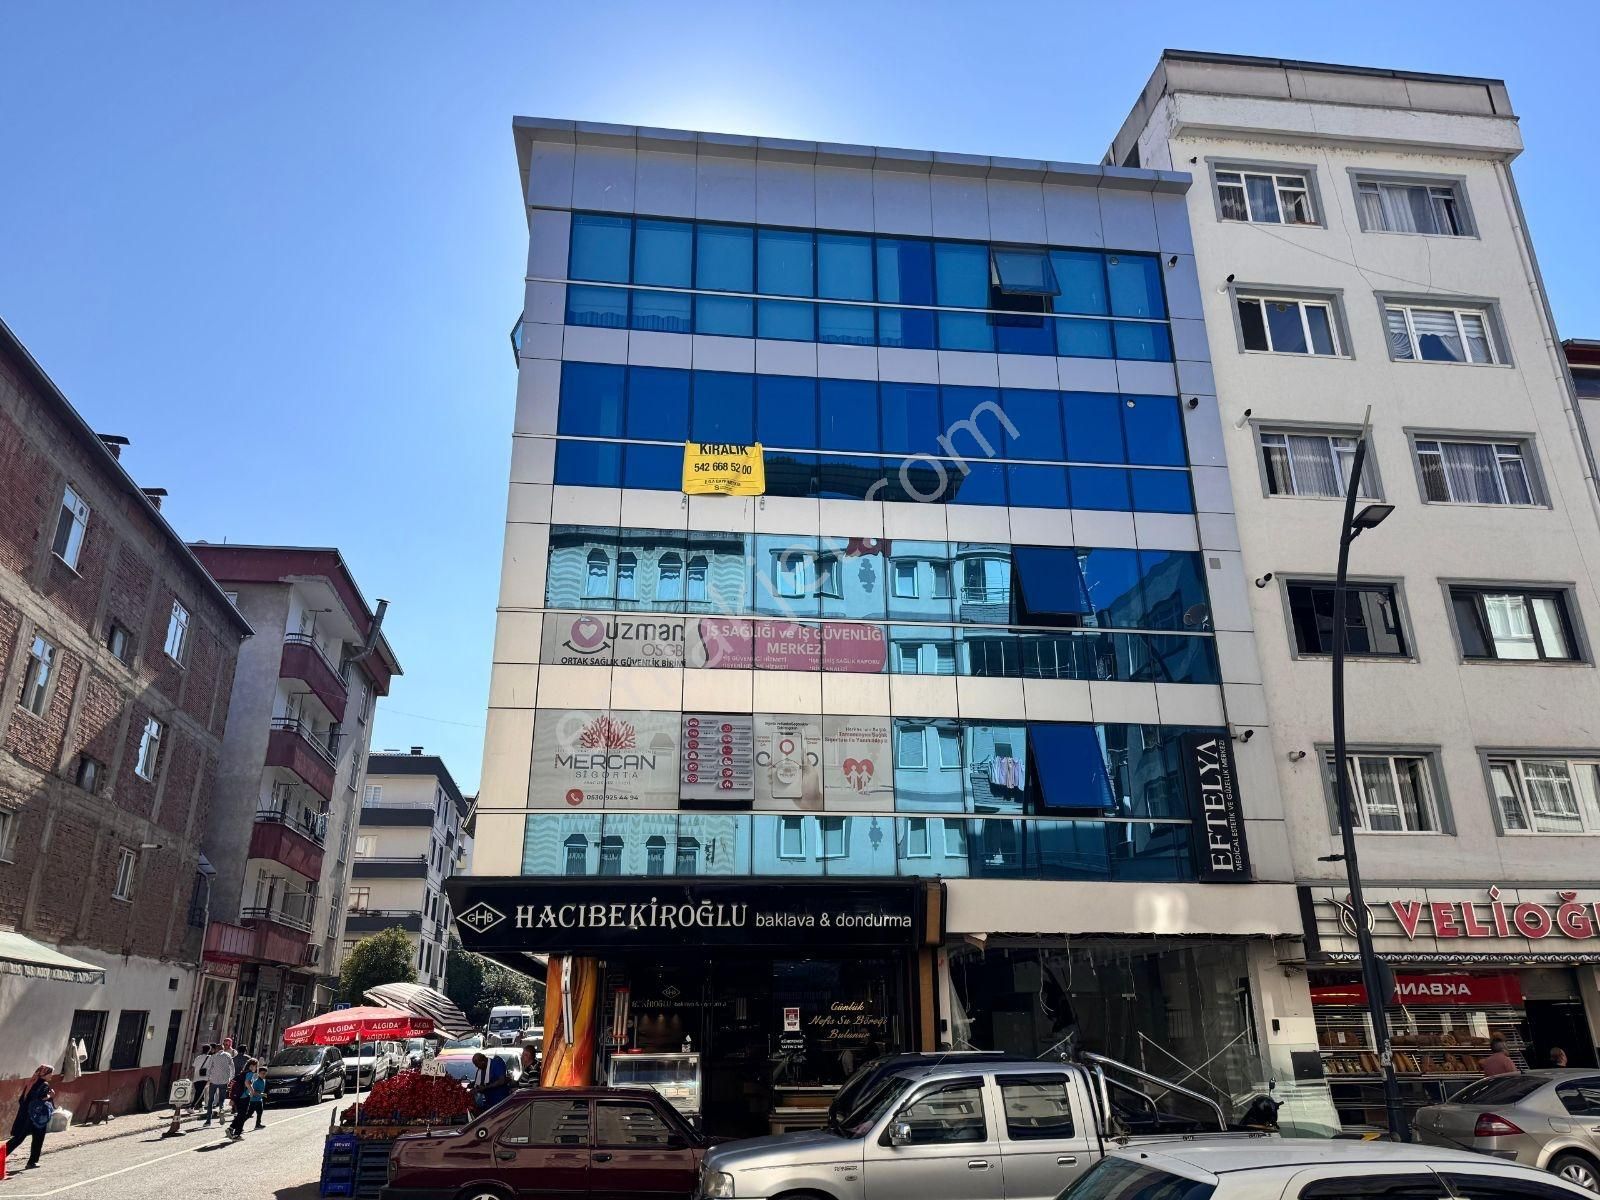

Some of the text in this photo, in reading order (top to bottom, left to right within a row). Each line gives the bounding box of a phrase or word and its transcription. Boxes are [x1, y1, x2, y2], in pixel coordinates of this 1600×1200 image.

[694, 462, 752, 475] 542 668 52 00
[606, 622, 685, 642] uzman
[778, 628, 795, 639] ve
[798, 625, 810, 640] İŞ
[642, 644, 684, 657] OSGB
[767, 641, 827, 655] MERKEZİ
[560, 656, 589, 666] ORTAK
[589, 656, 619, 666] SAĞLIK
[556, 753, 656, 770] MERCAN
[575, 770, 639, 779] SİGORTA
[1228, 801, 1235, 810] VE
[467, 896, 912, 930] GHB HACIBEKİROĞLU baklava & dondurma
[1389, 885, 1600, 941] VELİOĞ
[326, 1023, 355, 1034] ALGIDA
[371, 1021, 399, 1030] ALGIDA
